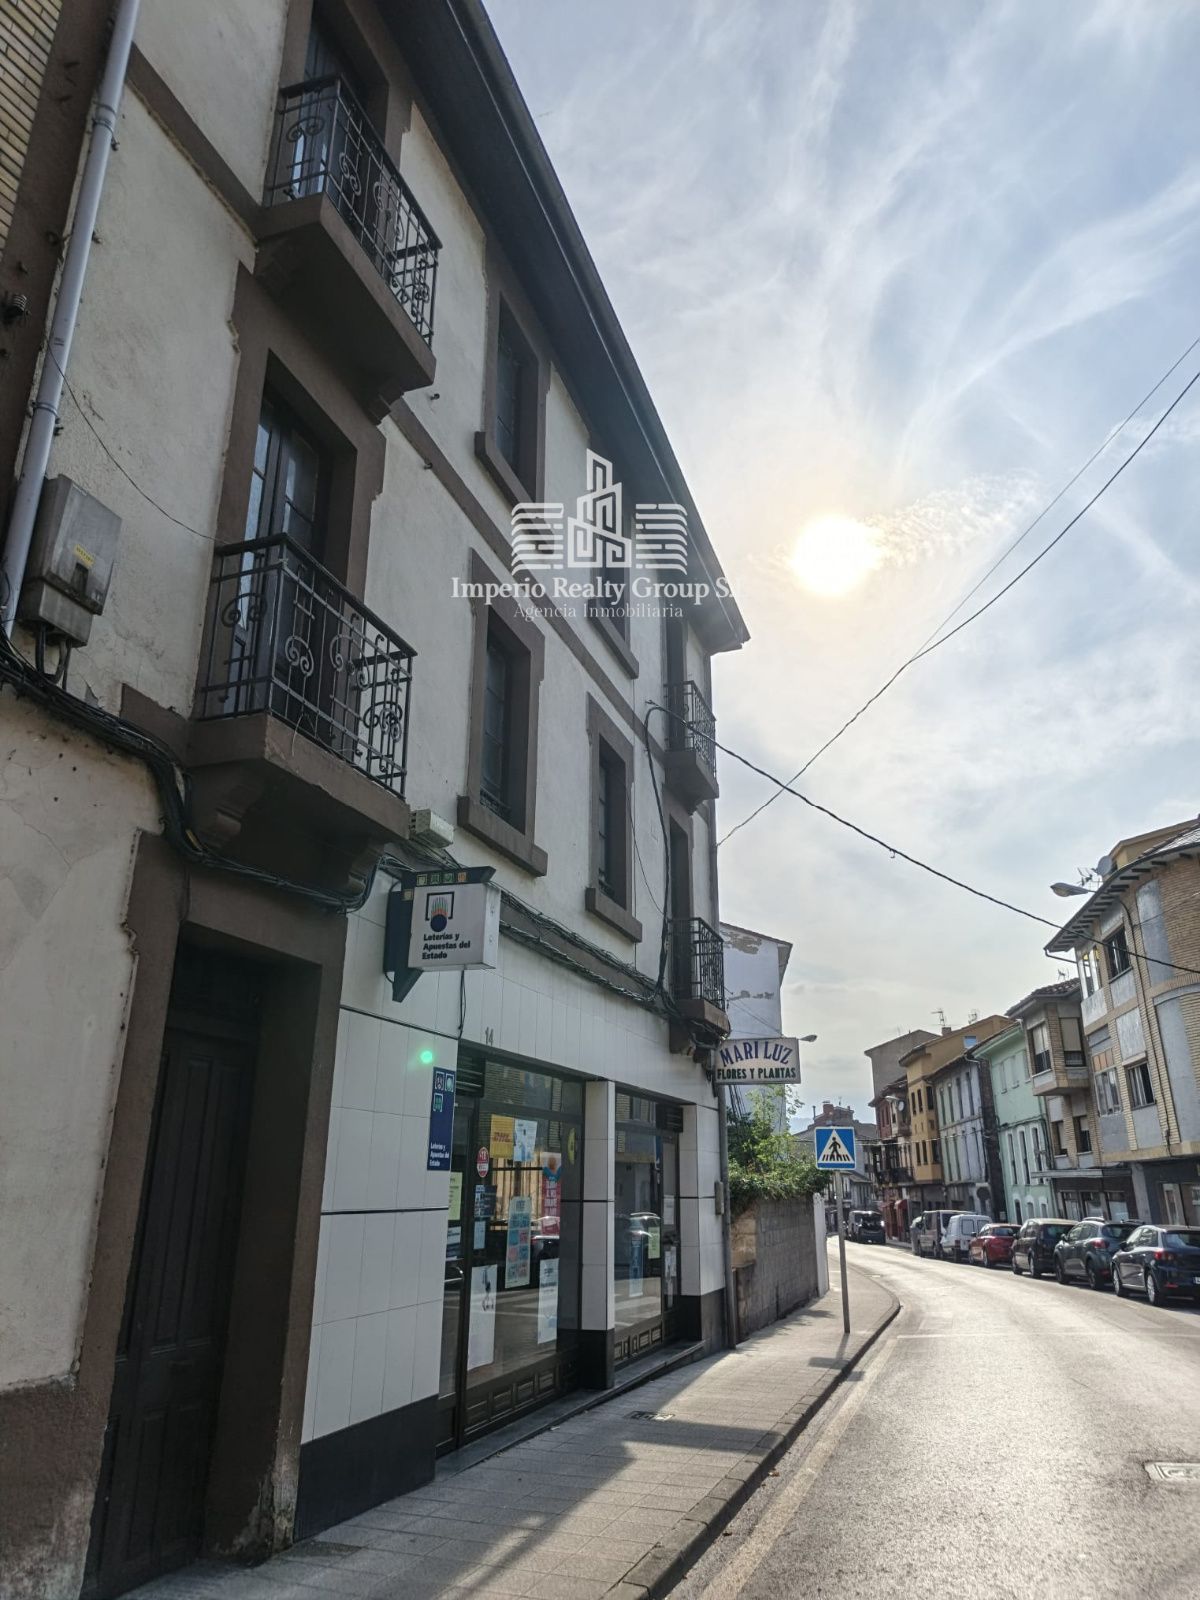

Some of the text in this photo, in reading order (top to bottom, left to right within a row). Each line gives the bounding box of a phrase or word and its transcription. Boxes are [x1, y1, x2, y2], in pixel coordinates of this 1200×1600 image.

[455, 933, 460, 941] y
[422, 941, 471, 951] Apuestas del
[421, 951, 448, 960] Estado
[484, 1026, 494, 1047] 14
[716, 1067, 797, 1080] FLORES Y PLANTAS
